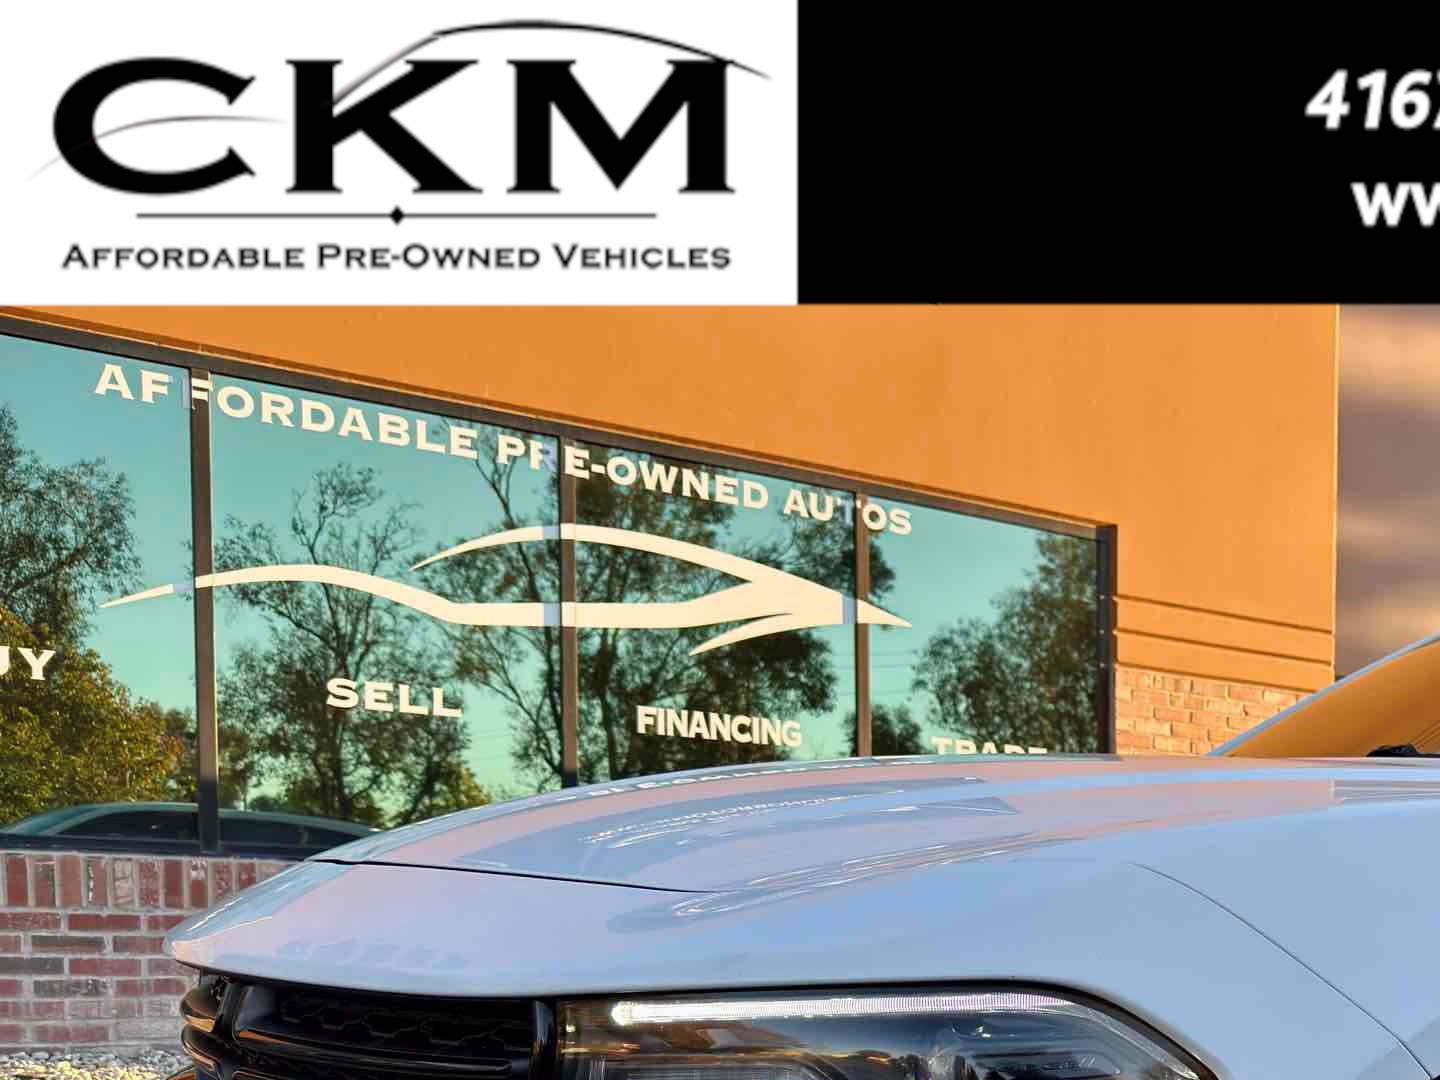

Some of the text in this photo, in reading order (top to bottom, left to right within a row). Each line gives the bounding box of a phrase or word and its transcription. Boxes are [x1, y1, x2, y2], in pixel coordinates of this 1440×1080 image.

[94, 363, 913, 536] AFFORDABLE PRE-OWNED AUTOS
[326, 678, 463, 718] SELL
[636, 704, 801, 747] FINANCING
